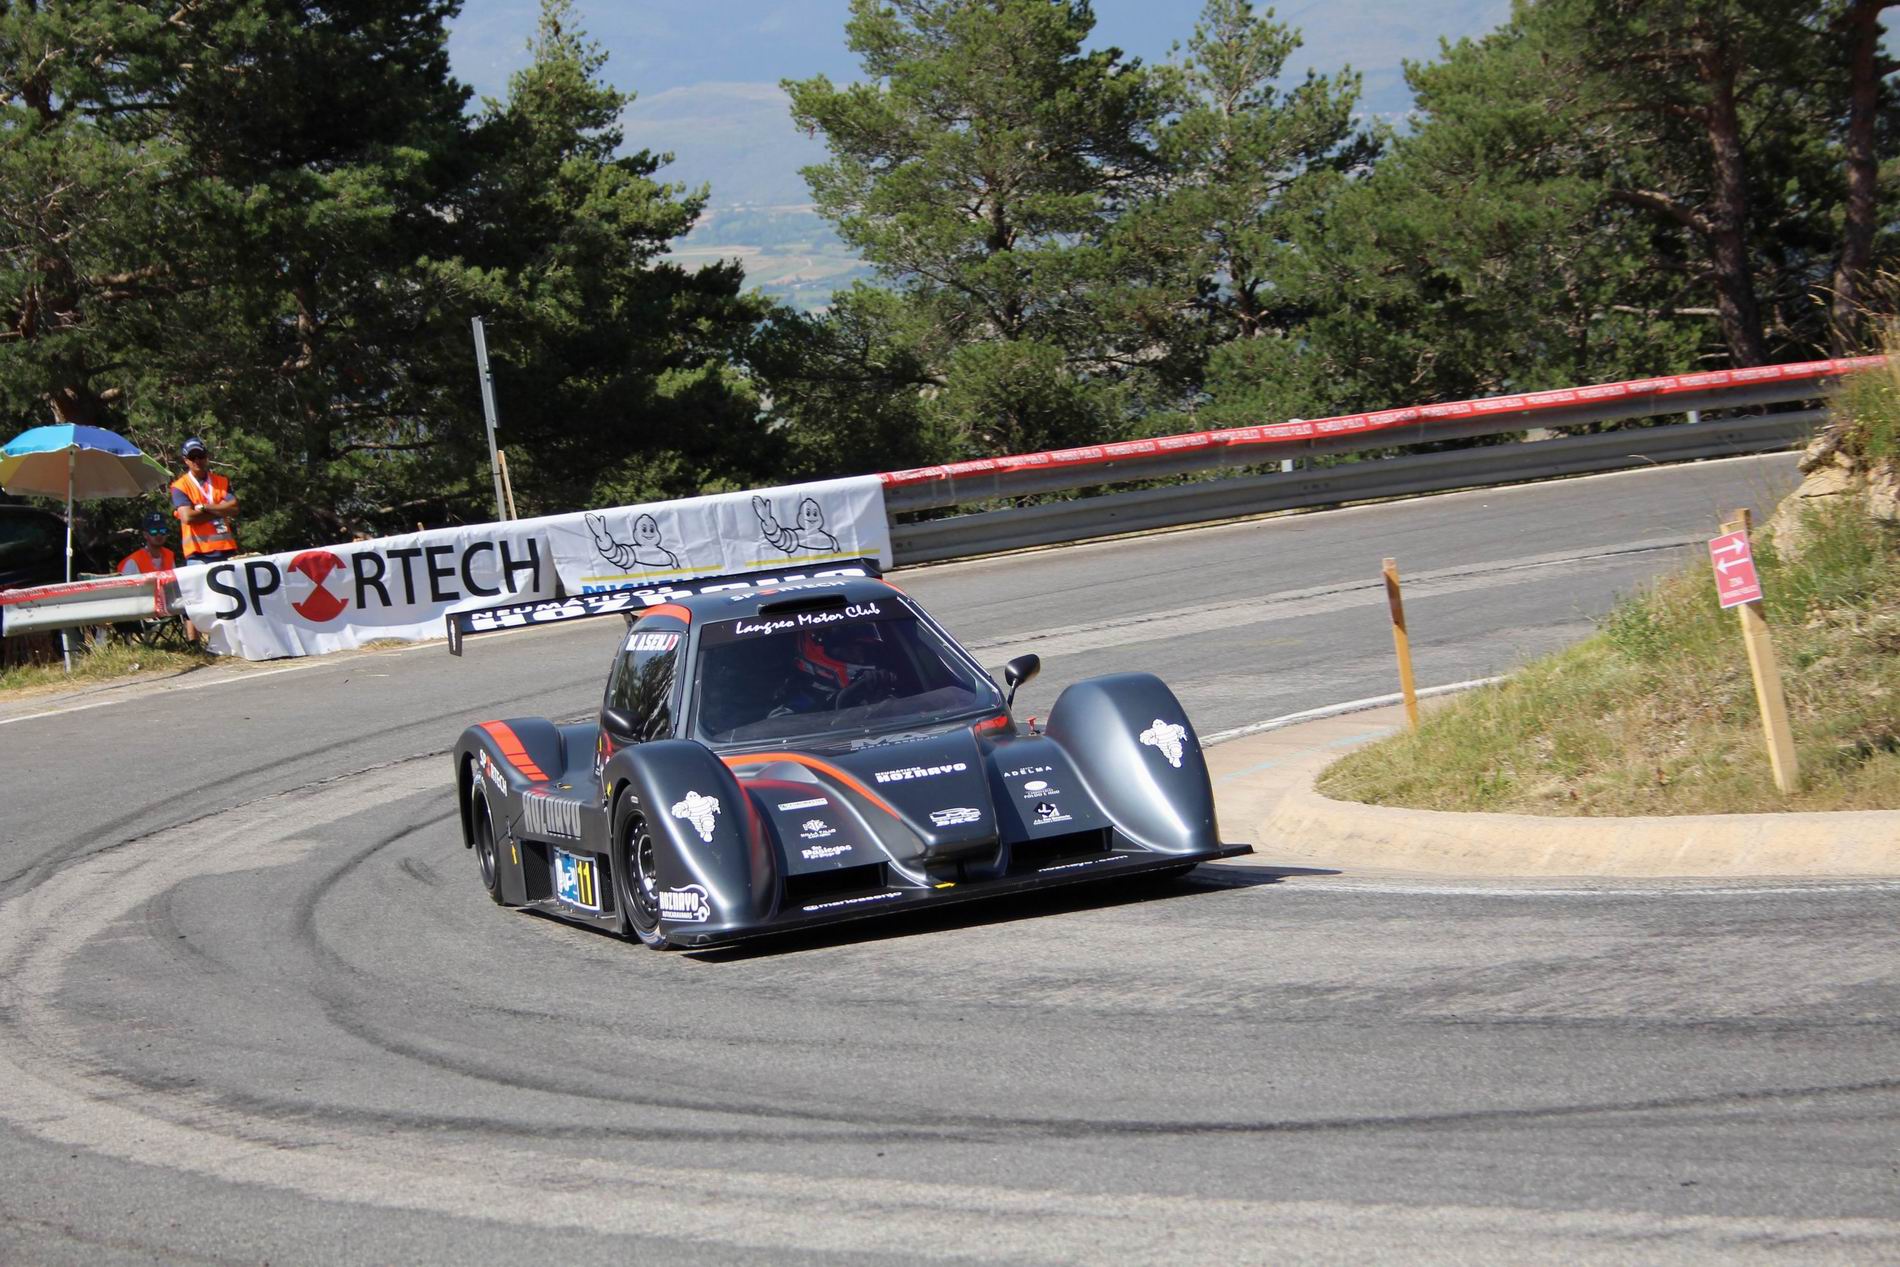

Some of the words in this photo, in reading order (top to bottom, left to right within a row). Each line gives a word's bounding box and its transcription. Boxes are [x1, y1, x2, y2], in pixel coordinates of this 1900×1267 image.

[206, 538, 541, 622] SPORTECH
[471, 586, 675, 620] NEUMÁTICOS
[736, 620, 795, 635] Langreo
[798, 612, 845, 626] Motor
[845, 602, 881, 618] Club
[577, 860, 593, 905] 11
